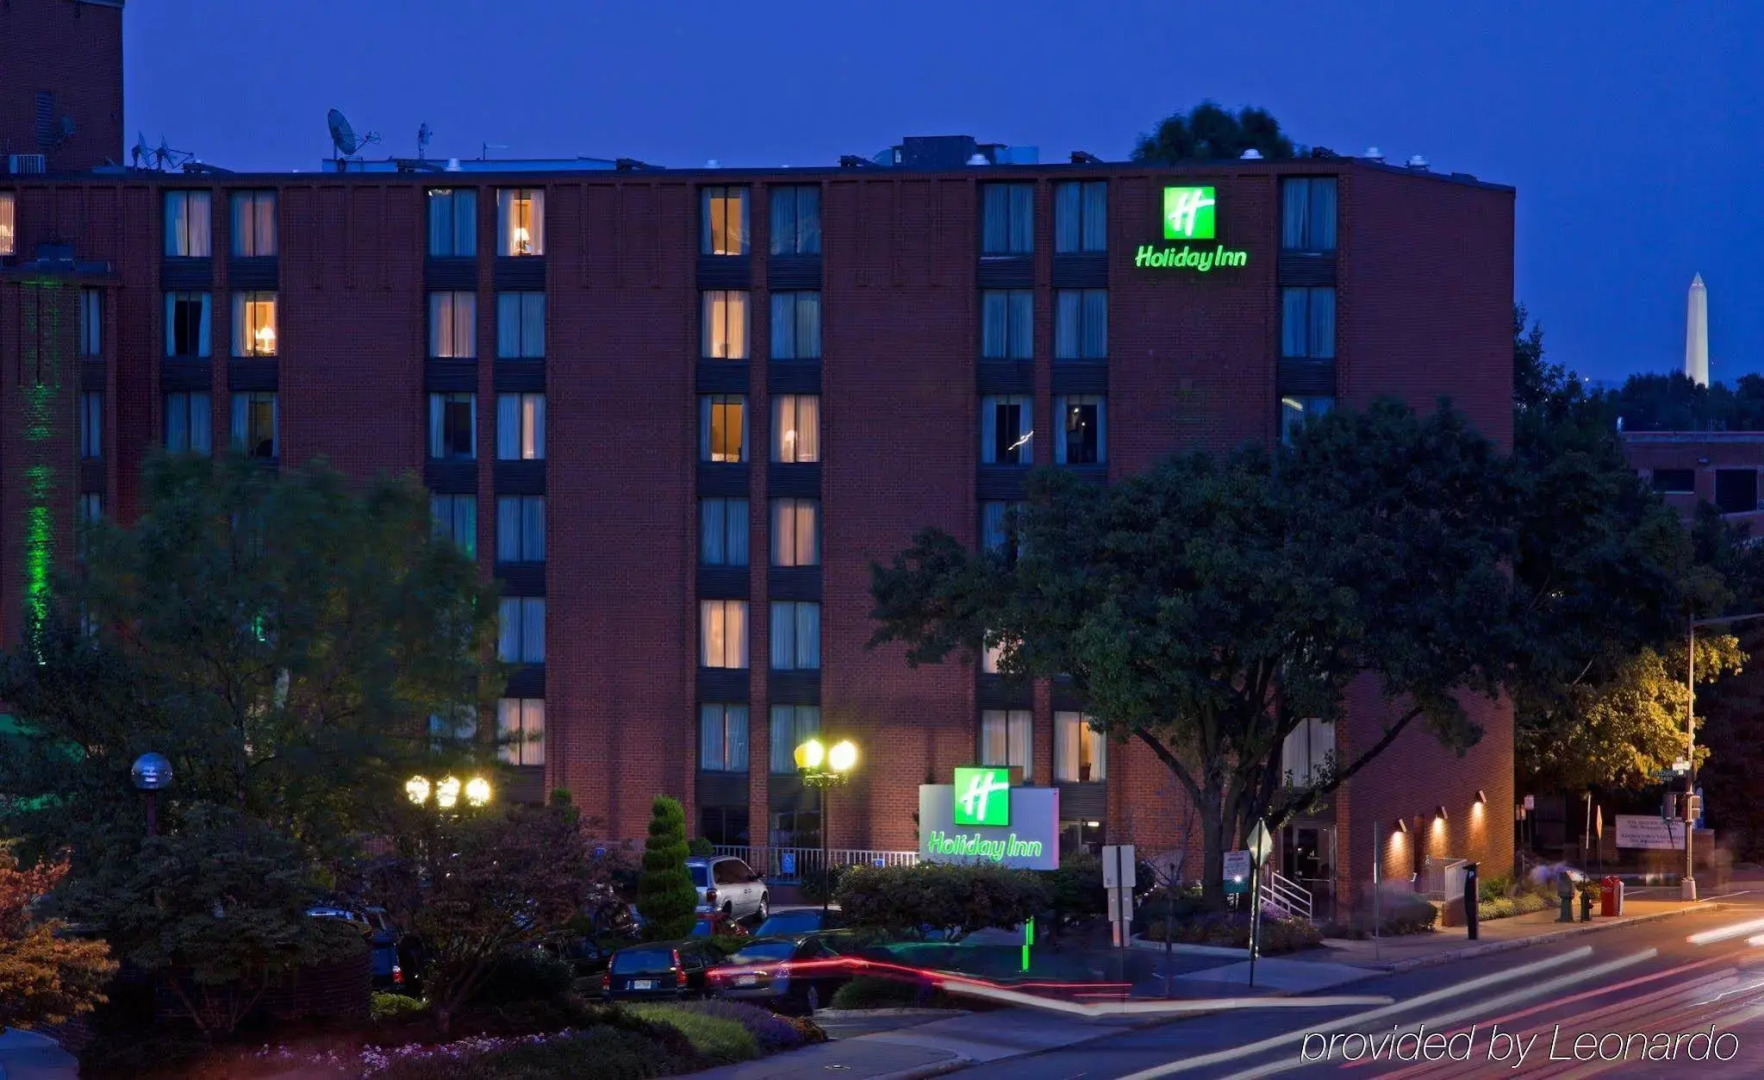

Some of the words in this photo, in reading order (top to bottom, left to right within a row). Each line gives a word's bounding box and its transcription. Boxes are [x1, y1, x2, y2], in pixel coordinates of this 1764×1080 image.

[1135, 245, 1214, 272] Holiday
[1214, 244, 1246, 267] Inn
[928, 831, 1005, 861] Holiday
[1007, 833, 1041, 856] Inn
